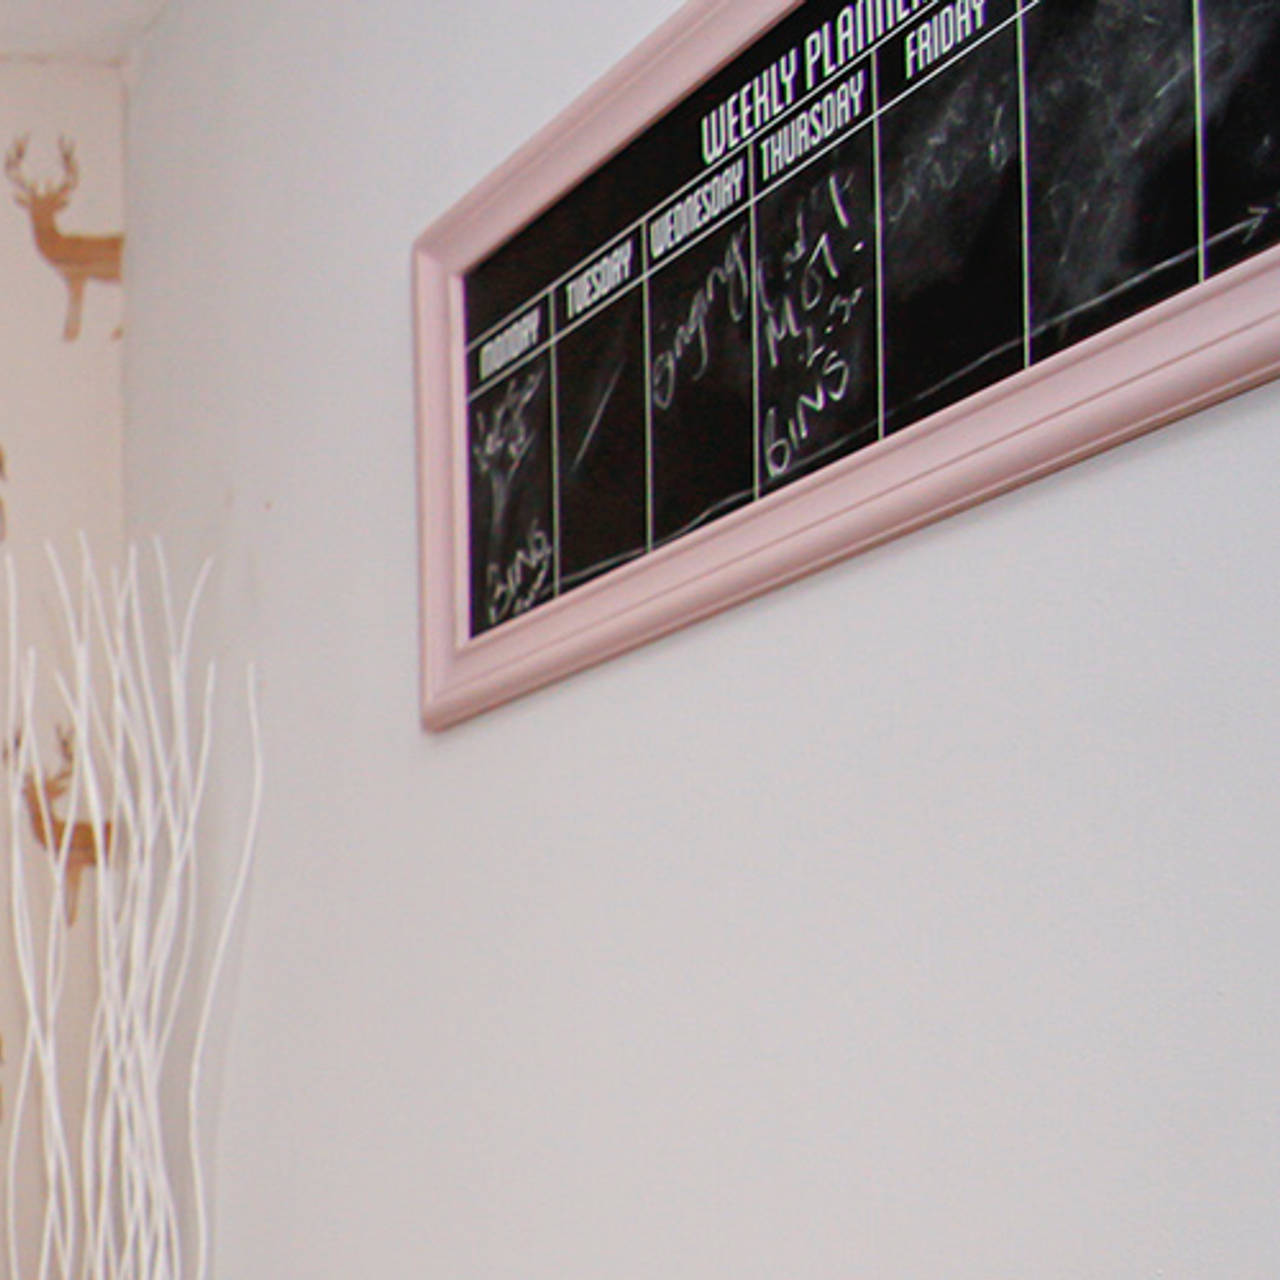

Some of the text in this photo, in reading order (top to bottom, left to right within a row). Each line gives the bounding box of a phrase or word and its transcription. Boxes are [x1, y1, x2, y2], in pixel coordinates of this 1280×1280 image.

[479, 307, 541, 381] MONDAY
[566, 238, 633, 319] TUESDAY
[650, 157, 745, 259] WEDNESDAY
[760, 69, 865, 181] THURSDAY
[904, 0, 986, 80] FRIDAY
[702, 48, 798, 165] WEEKLY
[804, 0, 928, 90] PLANN
